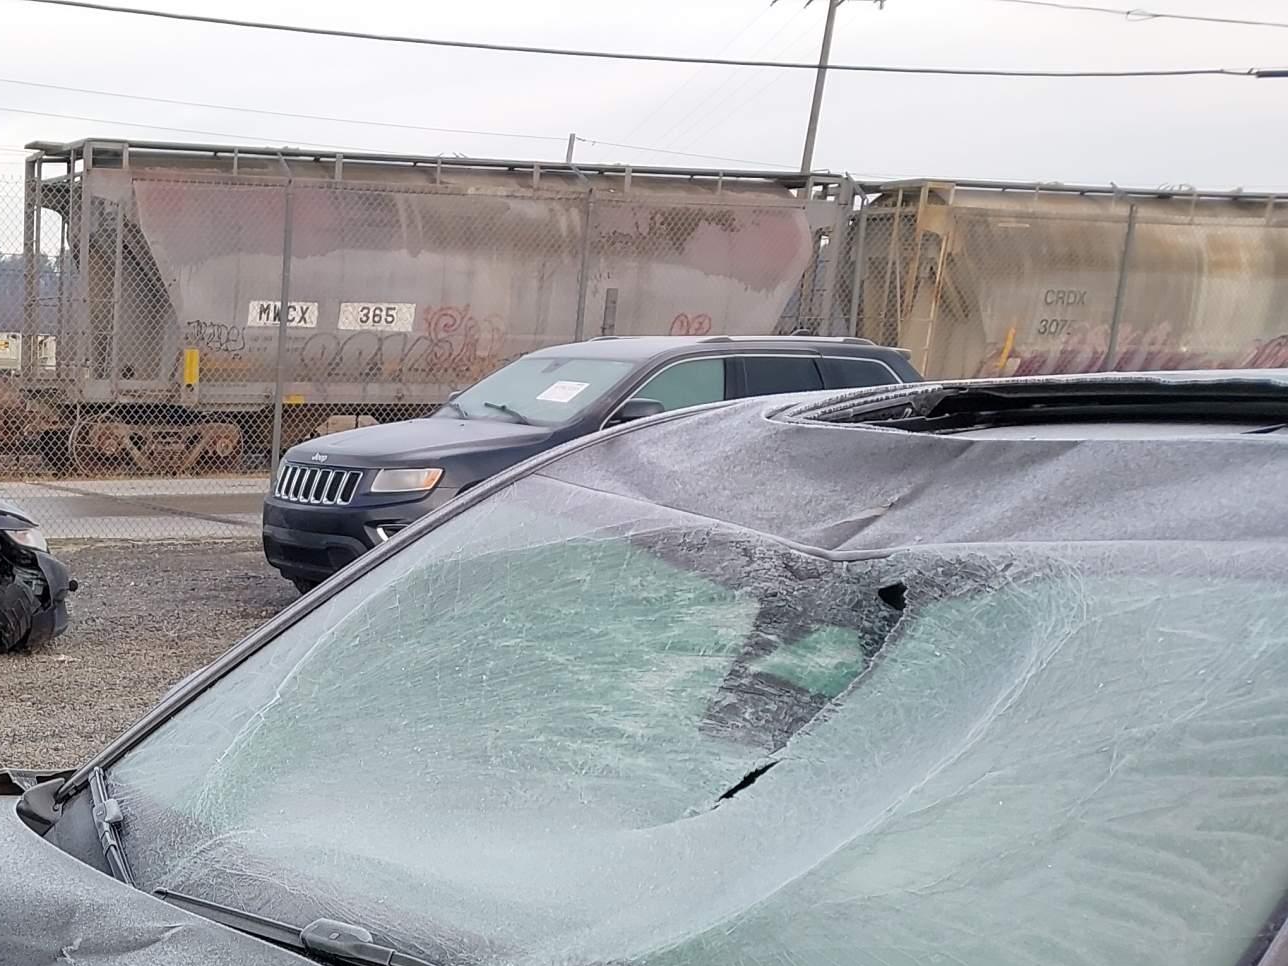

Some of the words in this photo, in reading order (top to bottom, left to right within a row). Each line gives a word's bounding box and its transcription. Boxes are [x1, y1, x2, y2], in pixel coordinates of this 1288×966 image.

[1044, 289, 1087, 305] CRDX
[258, 303, 310, 324] MWCX
[359, 305, 397, 325] 365
